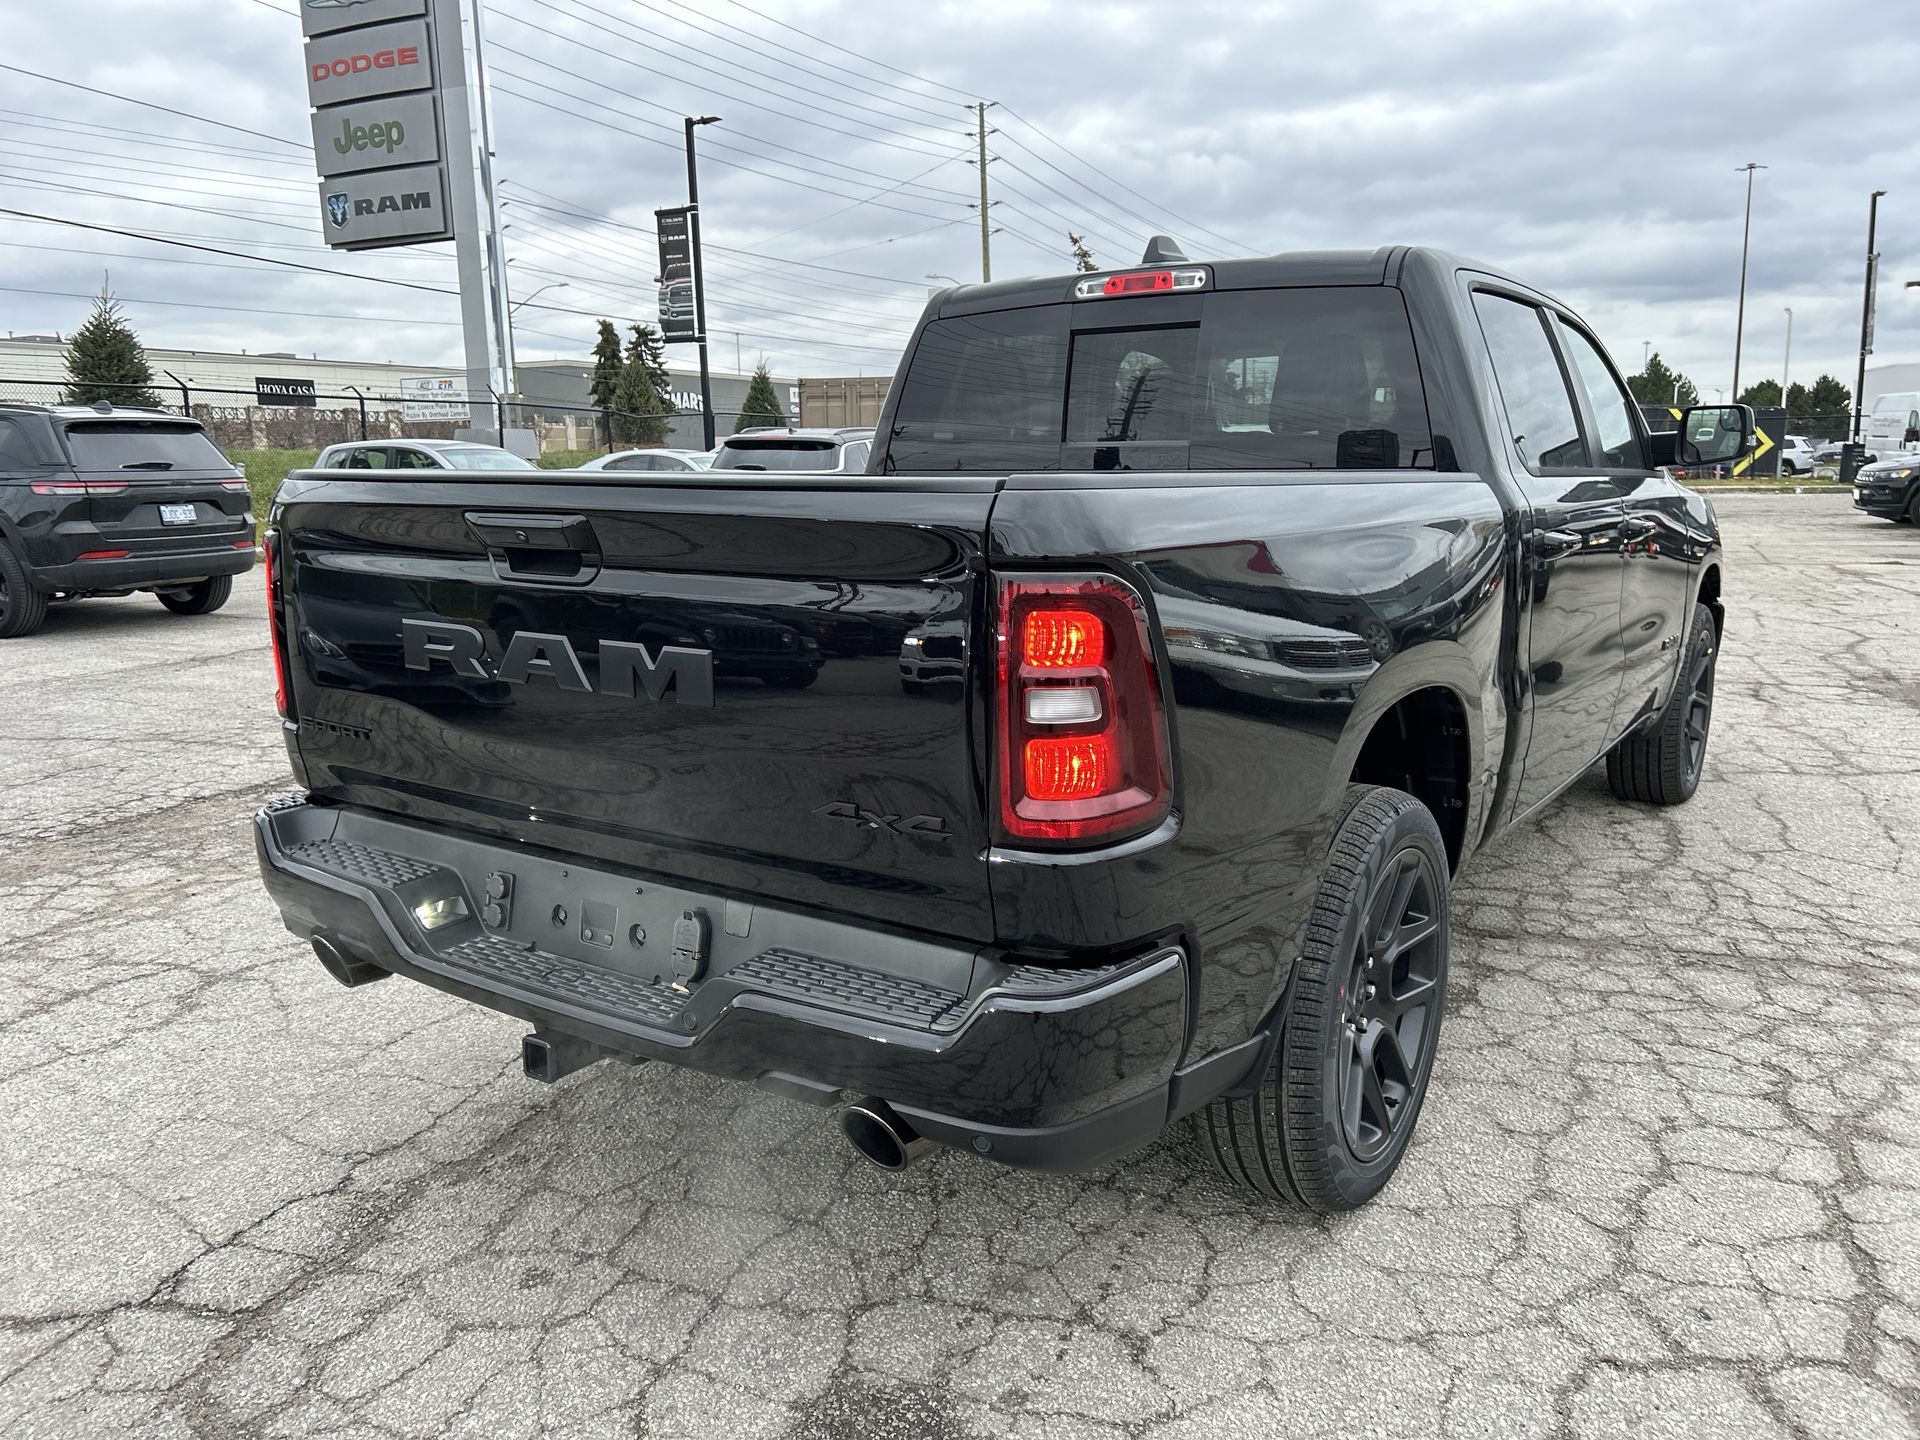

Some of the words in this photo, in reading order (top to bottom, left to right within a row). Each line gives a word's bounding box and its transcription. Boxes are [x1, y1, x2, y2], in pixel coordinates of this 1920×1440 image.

[312, 46, 419, 82] DODGE
[333, 118, 404, 154] Jeep
[353, 191, 431, 217] RAM
[258, 383, 288, 395] HOYA
[289, 385, 315, 396] CASA
[402, 618, 716, 707] RAM
